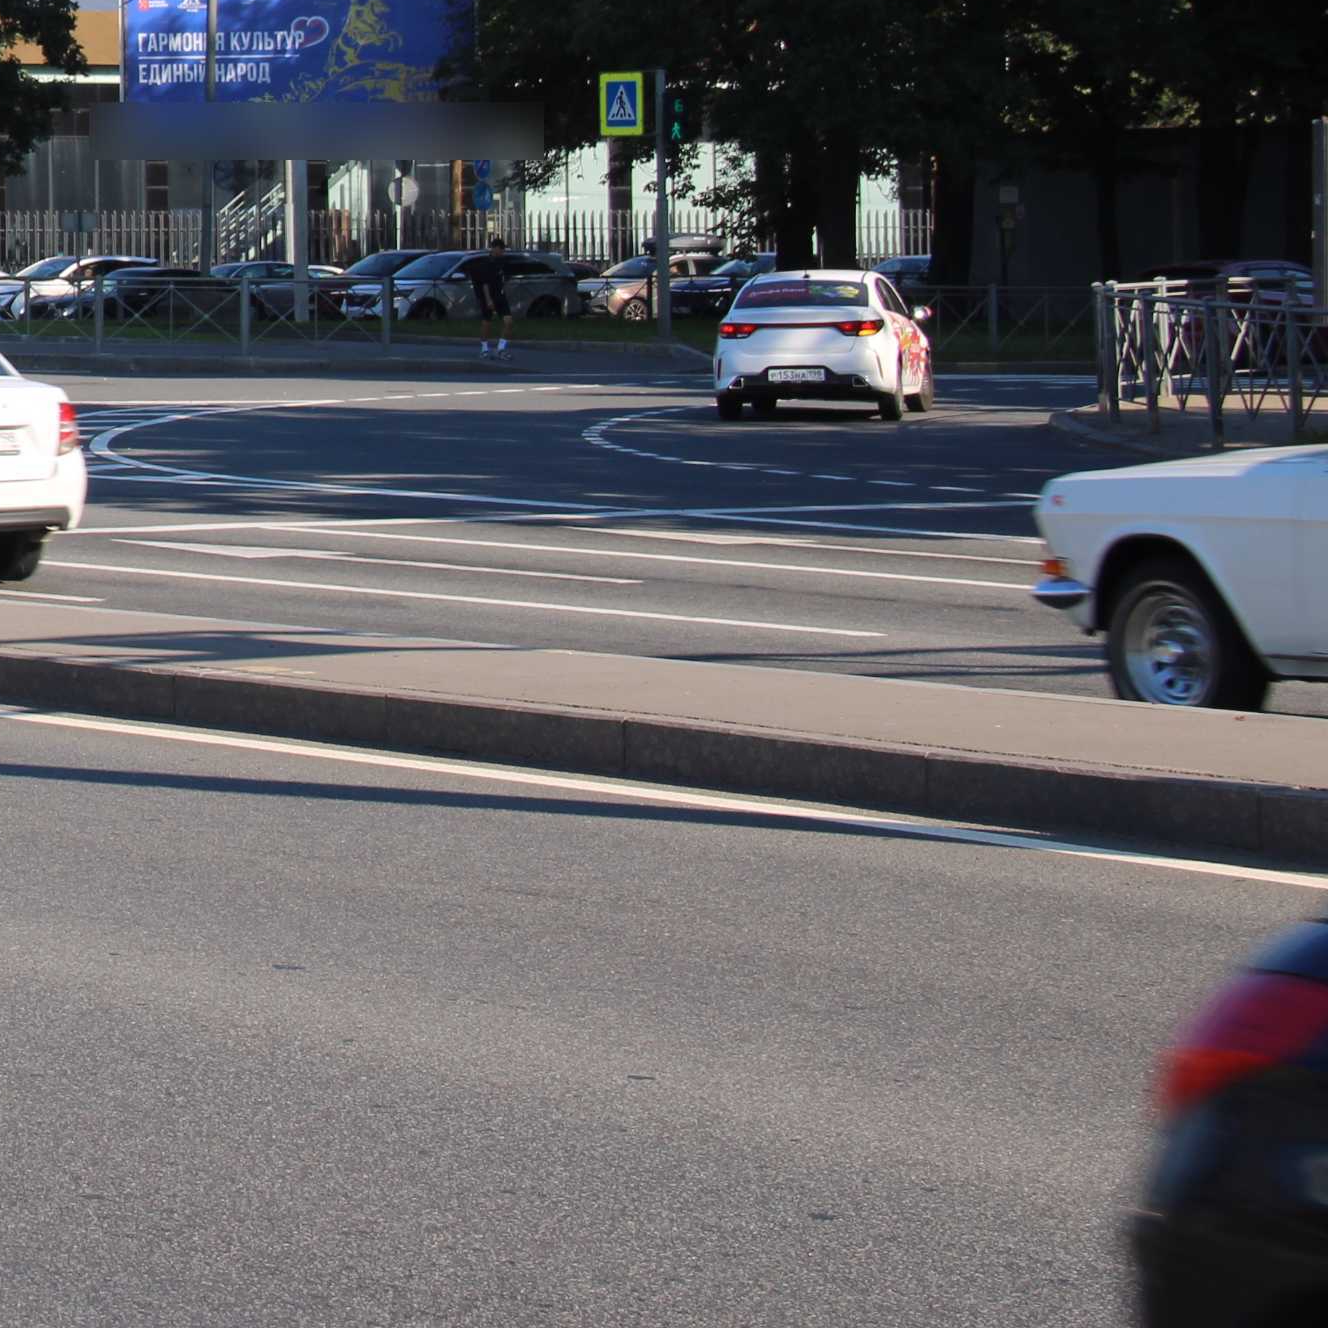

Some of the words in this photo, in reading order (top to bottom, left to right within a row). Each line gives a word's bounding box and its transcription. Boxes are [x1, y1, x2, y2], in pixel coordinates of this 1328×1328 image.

[137, 32, 225, 52] ГАРМОНЯ
[230, 30, 305, 51] КУЛЬТУР
[138, 59, 208, 85] ЕДИНЫЙ
[215, 62, 271, 84] НАРОД
